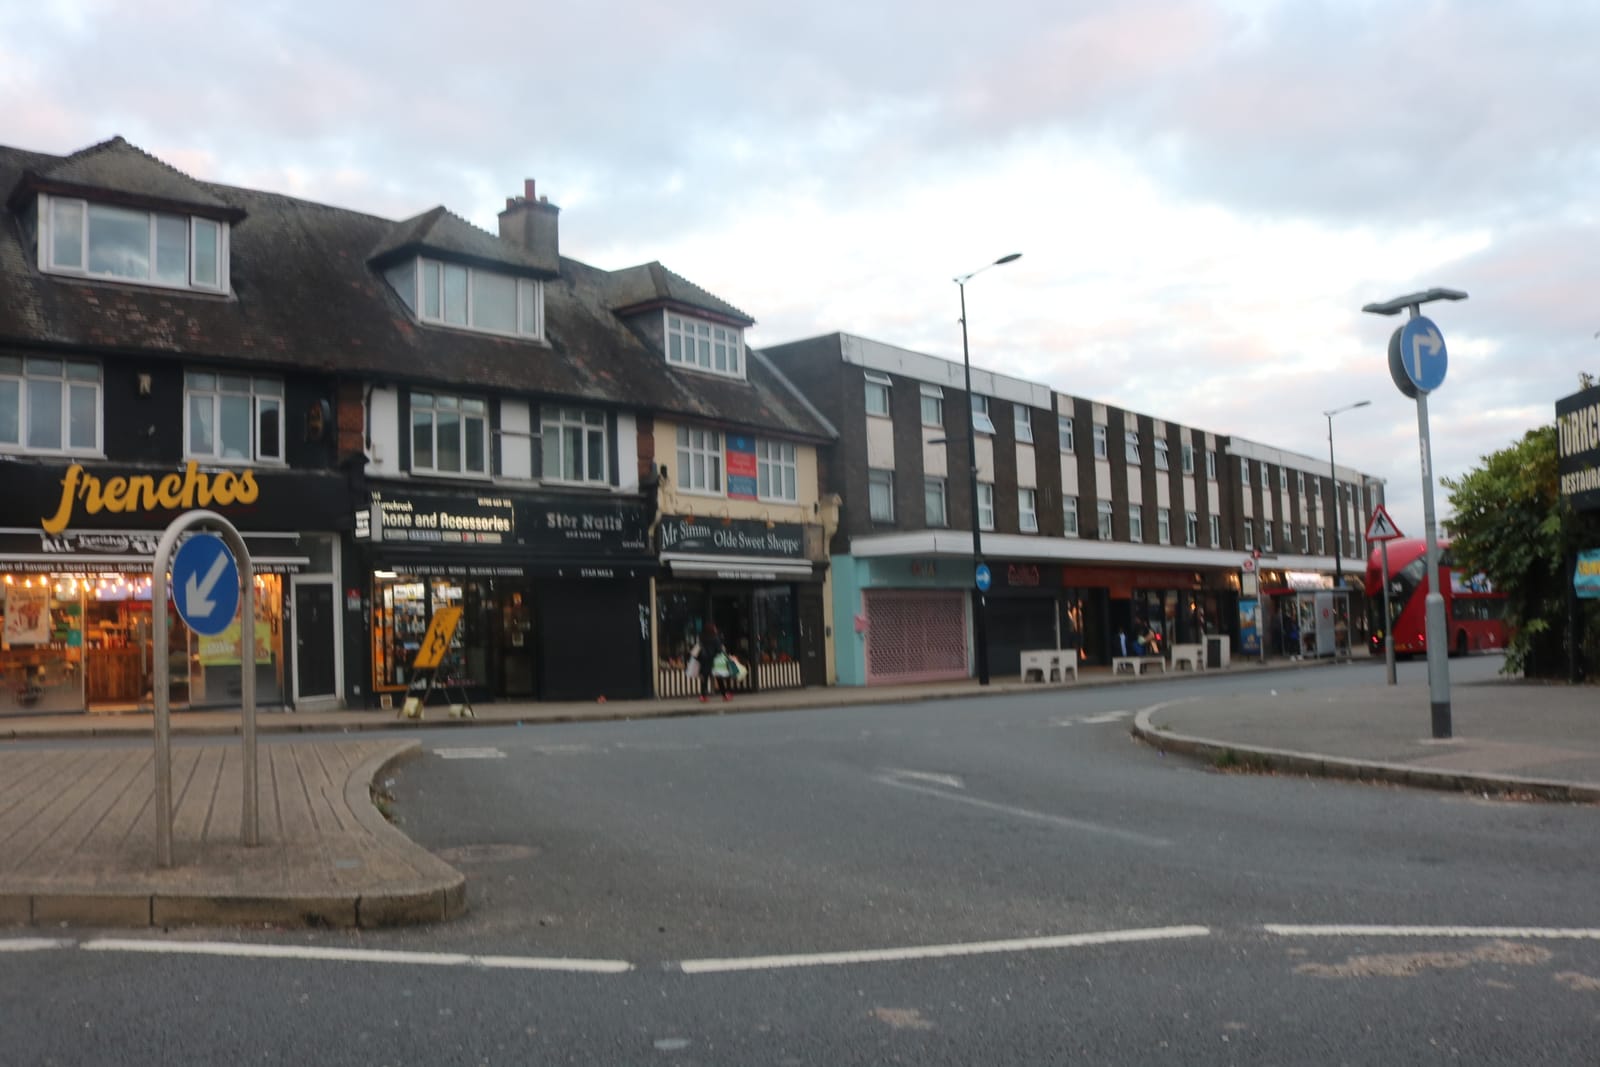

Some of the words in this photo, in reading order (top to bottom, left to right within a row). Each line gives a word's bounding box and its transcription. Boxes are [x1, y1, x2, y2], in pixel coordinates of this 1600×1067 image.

[41, 459, 259, 534] frenchos
[381, 510, 412, 528] hone
[414, 512, 438, 529] and
[440, 511, 511, 532] Accessories
[582, 514, 622, 531] Nails
[661, 521, 678, 550] Mr
[679, 519, 711, 541] Simms
[713, 529, 738, 549] Olde
[738, 531, 765, 550] Sweet
[766, 532, 799, 554] Shoppe
